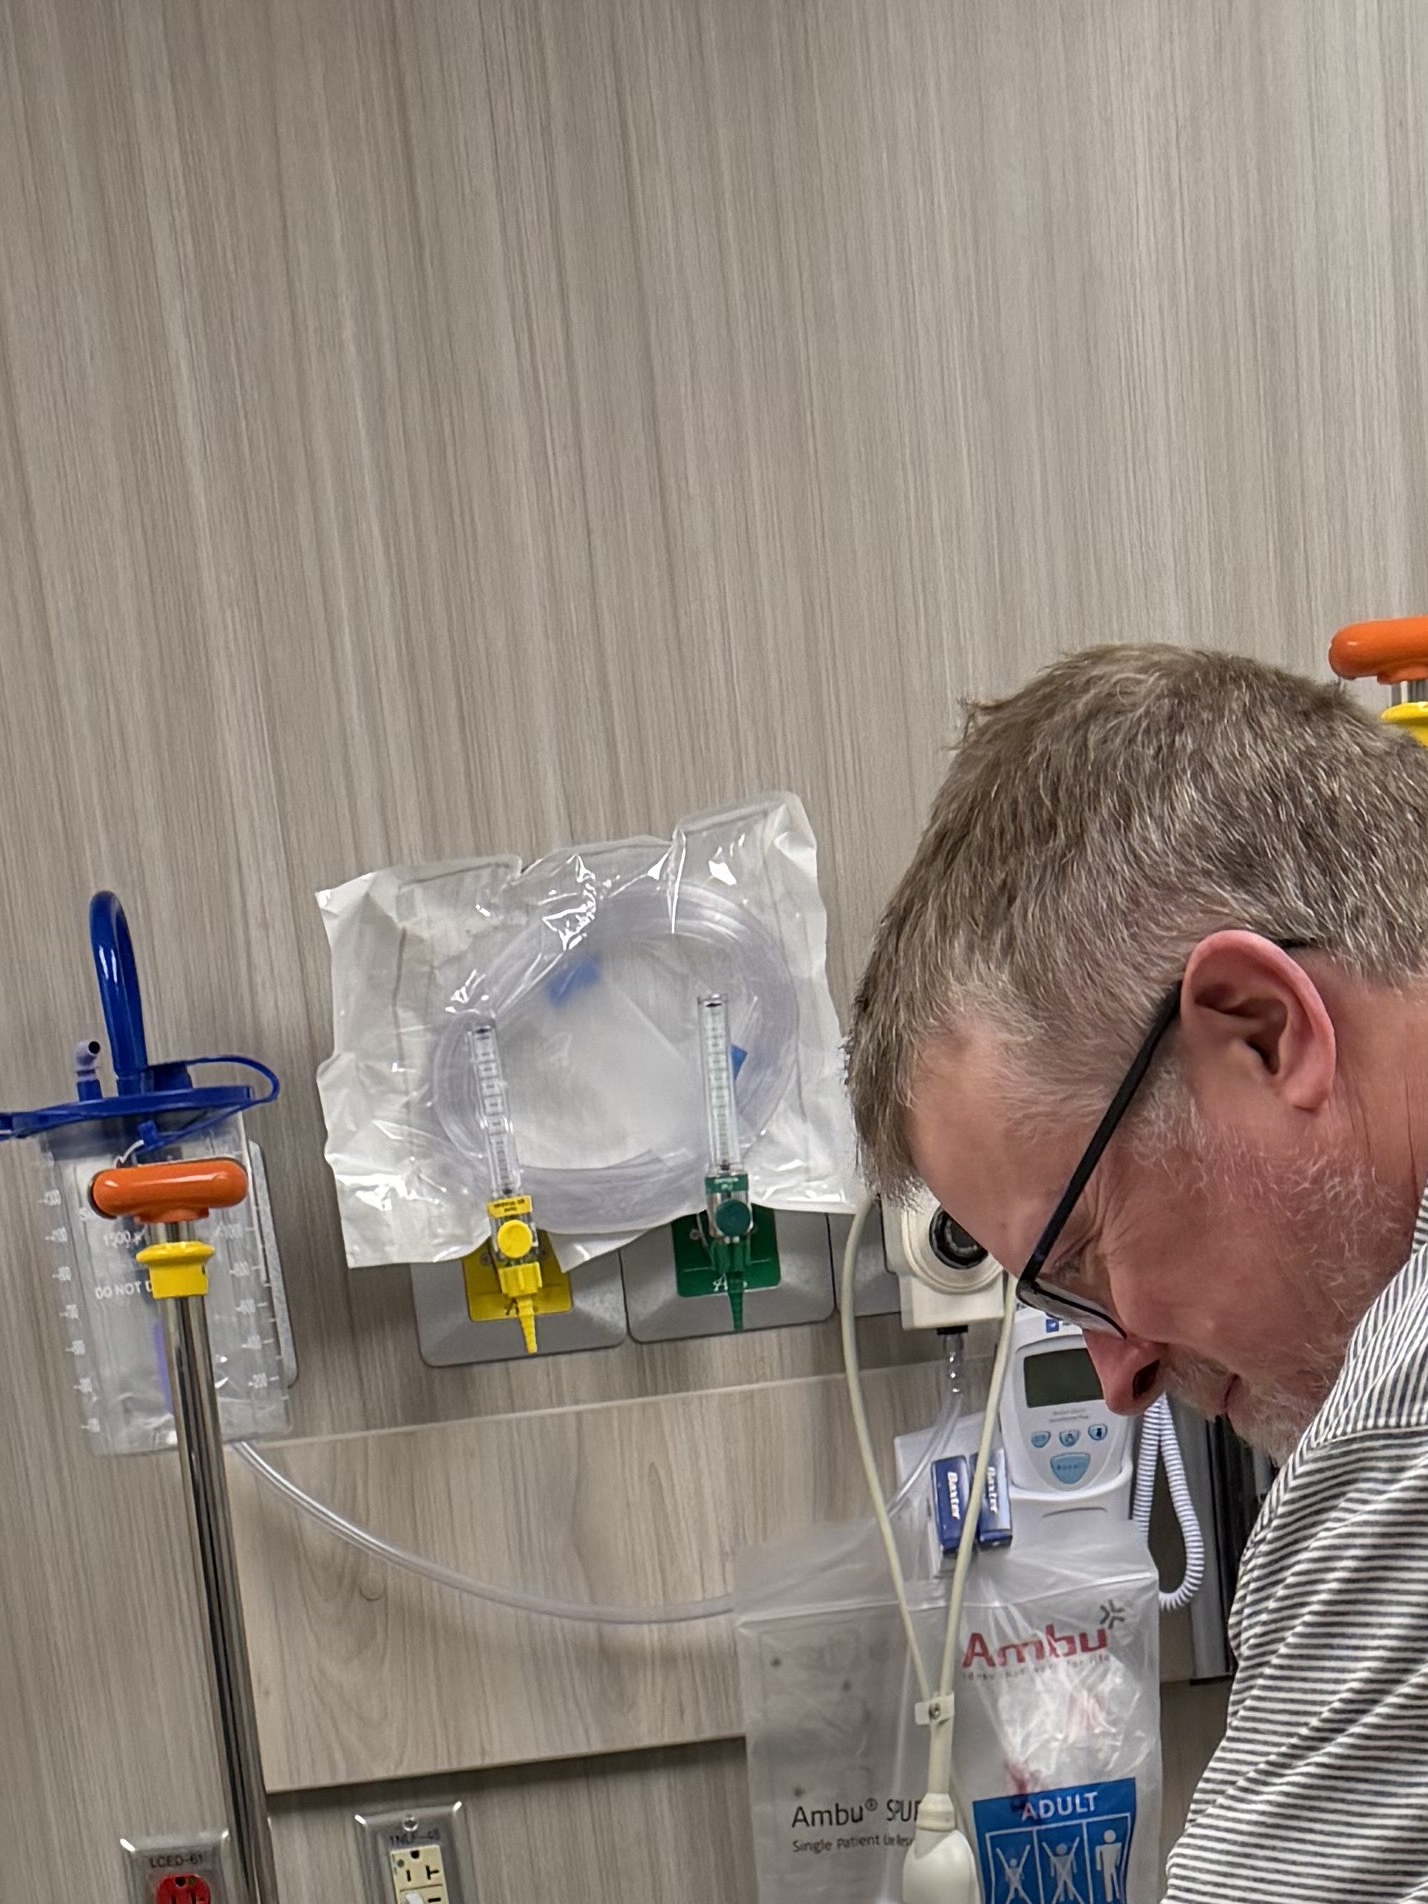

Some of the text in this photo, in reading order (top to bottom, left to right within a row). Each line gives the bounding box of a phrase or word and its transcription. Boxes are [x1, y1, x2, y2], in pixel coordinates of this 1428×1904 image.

[115, 1280, 141, 1296] NOT
[947, 1471, 960, 1520] Baxter
[962, 1623, 1108, 1668] Ambu
[1021, 1791, 1098, 1822] ADULT
[792, 1839, 832, 1854] Single
[836, 1834, 880, 1849] Patient
